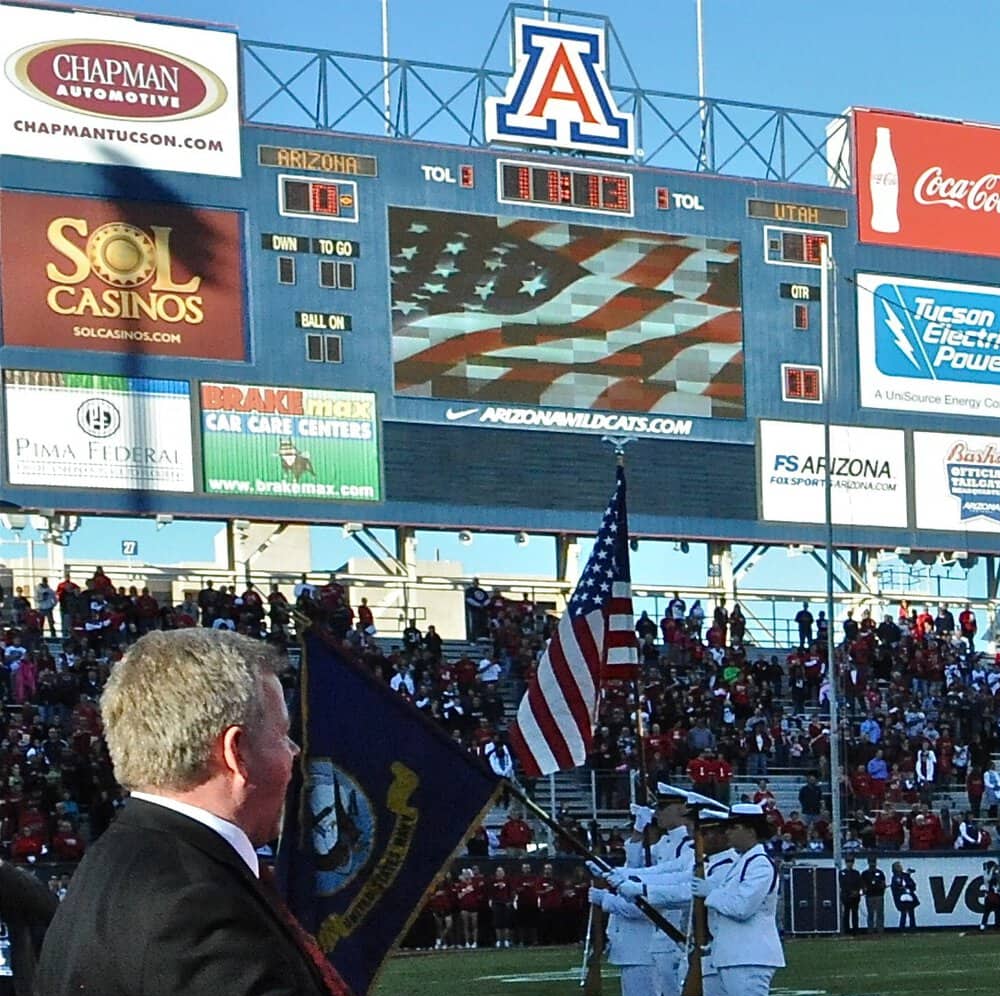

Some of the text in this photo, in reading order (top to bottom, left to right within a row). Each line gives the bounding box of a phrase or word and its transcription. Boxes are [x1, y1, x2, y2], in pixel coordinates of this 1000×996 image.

[53, 53, 180, 93] CHAPMAN
[56, 83, 181, 109] AUTOMOTIVE
[489, 19, 632, 153] A
[13, 119, 224, 153] CHAPMANTUCSON.COM
[277, 149, 358, 174] ARIZONA
[420, 164, 457, 183] TOL
[311, 183, 339, 215] 0
[671, 192, 705, 210] TOL
[774, 204, 819, 224] UTAH
[46, 216, 201, 293] SOL
[272, 235, 297, 252] DWN
[319, 239, 352, 256] TO GO
[47, 285, 204, 325] CASINOS
[913, 296, 995, 327] Tucson
[301, 312, 345, 330] BALL ON
[73, 325, 182, 344] SOLCASINOS.COM
[874, 389, 883, 399] A
[885, 390, 942, 404] UniSource
[944, 394, 982, 409] Energy
[205, 413, 372, 440] CAR CARE CENTERS
[480, 406, 693, 436] ARIZONAWILDCATS.COM
[16, 437, 76, 459] PIMA
[774, 454, 799, 472] FS
[208, 478, 374, 498] www.brakemax.com
